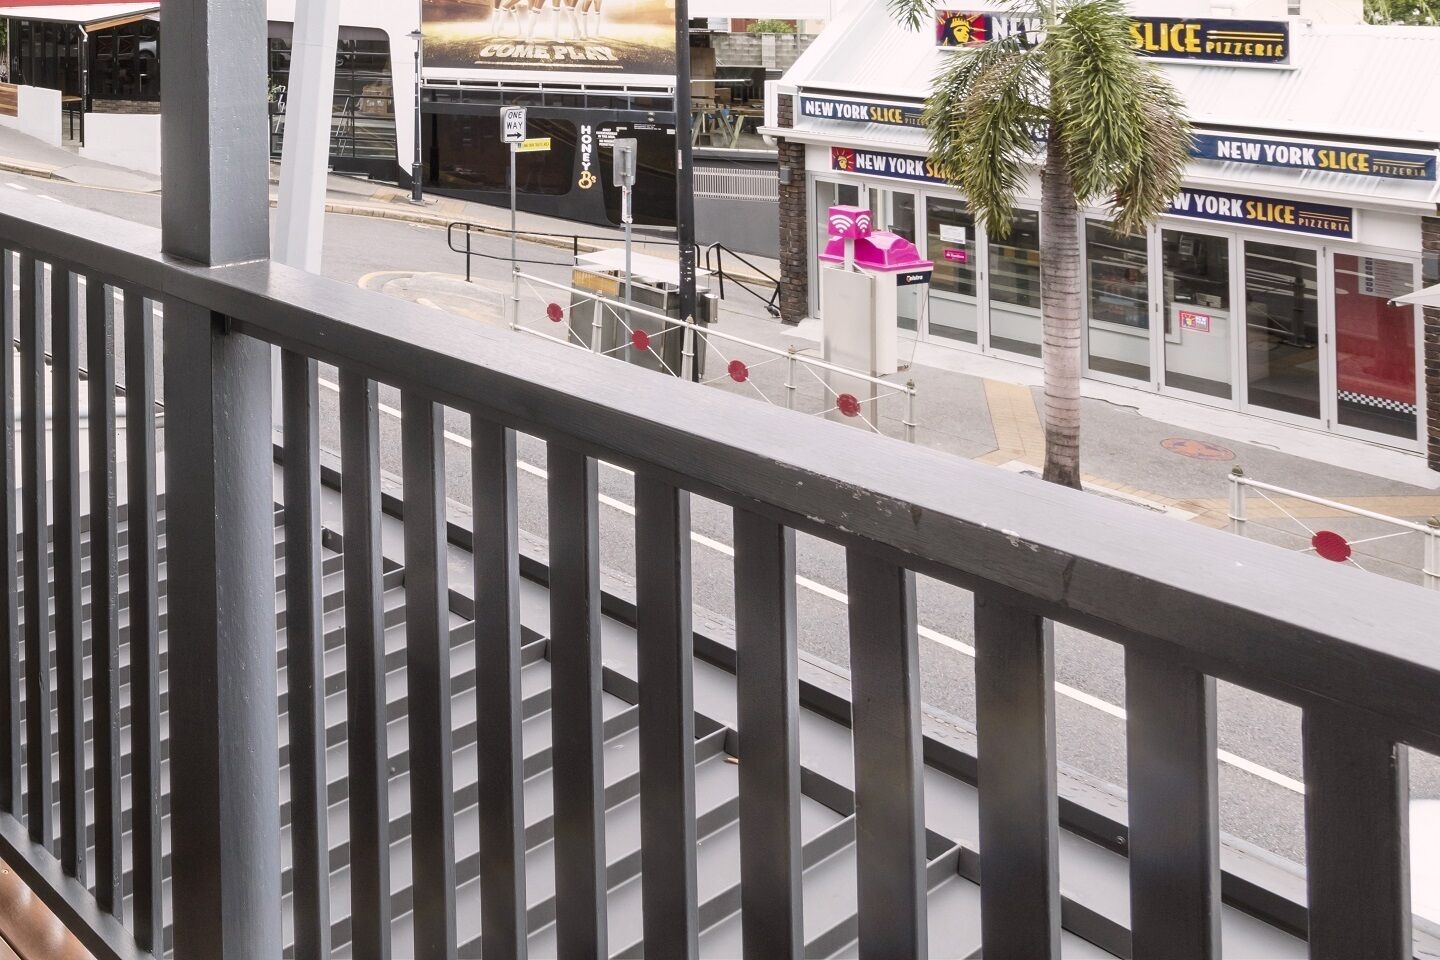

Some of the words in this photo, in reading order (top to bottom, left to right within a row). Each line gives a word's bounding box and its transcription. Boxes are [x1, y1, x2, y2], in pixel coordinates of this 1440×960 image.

[1127, 22, 1201, 53] SLICE
[1205, 41, 1284, 57] PIZZERIA
[479, 44, 550, 59] COME
[553, 46, 619, 61] PLAY
[508, 111, 522, 119] ONE
[805, 100, 833, 117] NEW
[835, 102, 869, 120] YORK
[869, 106, 903, 124] SLICE
[507, 122, 522, 130] WAY
[581, 125, 592, 171] HONEY
[1217, 140, 1261, 161] NEW
[1263, 144, 1315, 166] YORK
[1317, 149, 1370, 172] SLICE
[1372, 165, 1426, 177] PIZZERIA
[855, 153, 886, 172] NEW
[888, 156, 924, 176] YORK
[1193, 194, 1244, 218] YORK
[1245, 201, 1295, 225] SLICE
[1298, 217, 1350, 232] PIZZERIA
